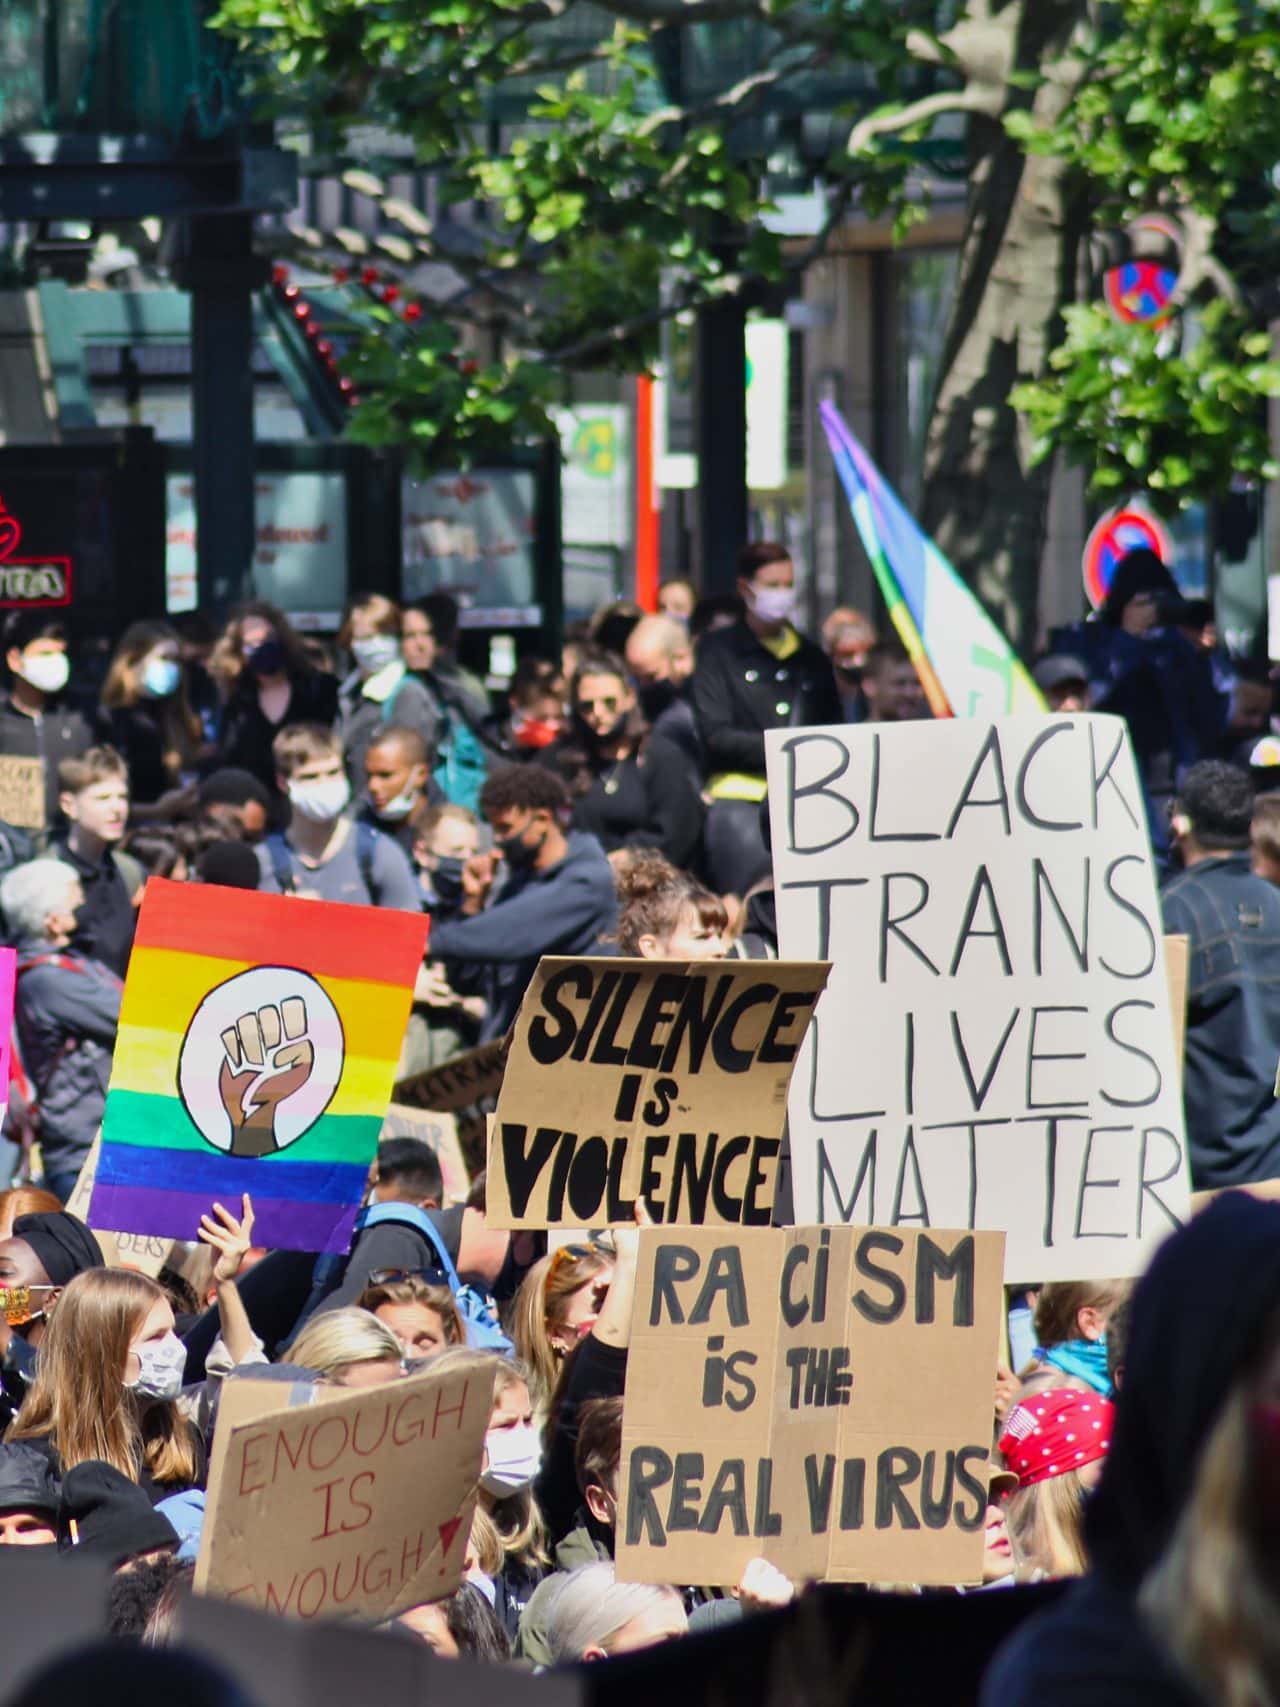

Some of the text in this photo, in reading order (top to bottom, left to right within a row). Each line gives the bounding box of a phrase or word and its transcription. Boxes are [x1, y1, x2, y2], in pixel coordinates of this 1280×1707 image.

[781, 721, 1140, 855] BLACK
[781, 854, 1157, 984] TRANS
[527, 964, 818, 1075] SILENCE
[808, 999, 1163, 1123] LIVES
[614, 1074, 680, 1128] IS
[501, 1122, 781, 1226] VIOLENCE
[817, 1112, 1187, 1248] MATTER
[785, 1346, 854, 1410] THE
[238, 1378, 470, 1497] ENOUGH
[311, 1471, 376, 1542] IS
[624, 1445, 990, 1548] REAL VIRUS
[226, 1516, 463, 1619] NOUGH!
